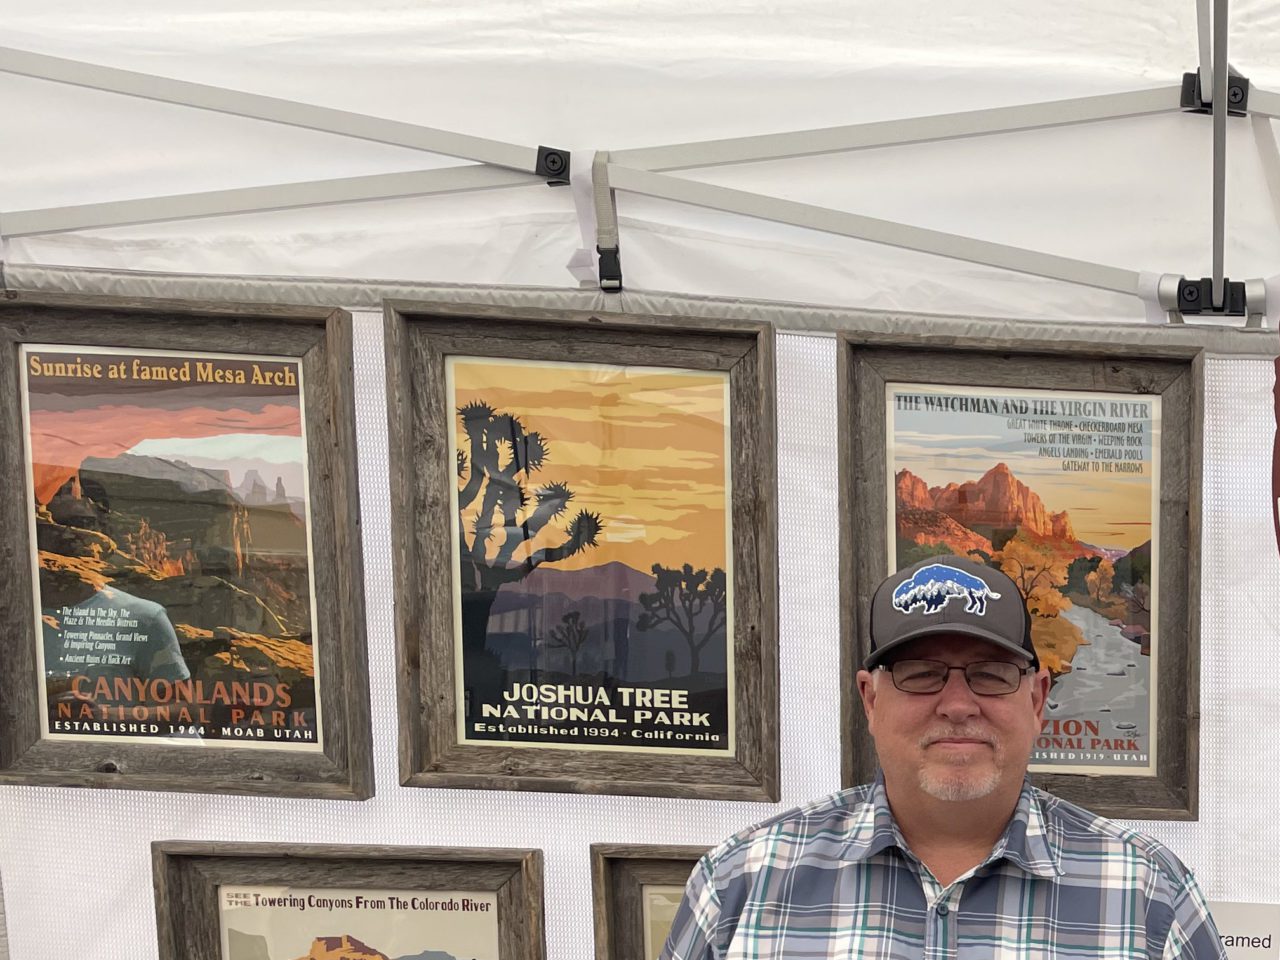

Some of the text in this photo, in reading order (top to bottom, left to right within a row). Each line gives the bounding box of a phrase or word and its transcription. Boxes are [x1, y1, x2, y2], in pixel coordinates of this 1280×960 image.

[30, 356, 296, 386] Sunrise at famed Mesa Arch
[895, 395, 1149, 419] THE WATCHMAN AND THE VIRGIN RIVER
[1079, 421, 1126, 433] CHECKERBOARD
[1128, 422, 1143, 434] MESA
[1024, 433, 1047, 444] TOWERS
[1058, 434, 1070, 444] THE
[1072, 434, 1092, 445] VIRGIN
[1098, 435, 1125, 446] WEEPING
[1126, 436, 1143, 447] ROCK
[1038, 447, 1143, 460] ANGELS LANDING EMERALD POOLS
[1062, 461, 1143, 473] GATEWAY TO THE NARROWS
[63, 607, 72, 616] The
[97, 608, 107, 617] The
[120, 608, 130, 618] The
[86, 617, 95, 625] The
[64, 630, 88, 641] Towering
[116, 632, 133, 641] Grand
[133, 633, 148, 642] Views
[95, 641, 116, 651] Canyons
[65, 654, 85, 662] Ancient
[121, 656, 132, 665] Art
[72, 675, 292, 708] CANYONLANDS
[503, 682, 689, 709] JOSHUA TREE
[58, 702, 308, 727] NATIONAL PARK
[482, 703, 711, 727] NATIONAL PARK
[55, 721, 313, 740] ESTABLISHED 1964 MOAB UTAH
[474, 722, 720, 742] Established 1994 California
[1040, 719, 1100, 736] ZION
[1090, 738, 1140, 751] PARK
[1080, 752, 1104, 760] 1919
[253, 894, 491, 912] Towering Canyons From The Colorado River
[1219, 934, 1272, 948] ramed
